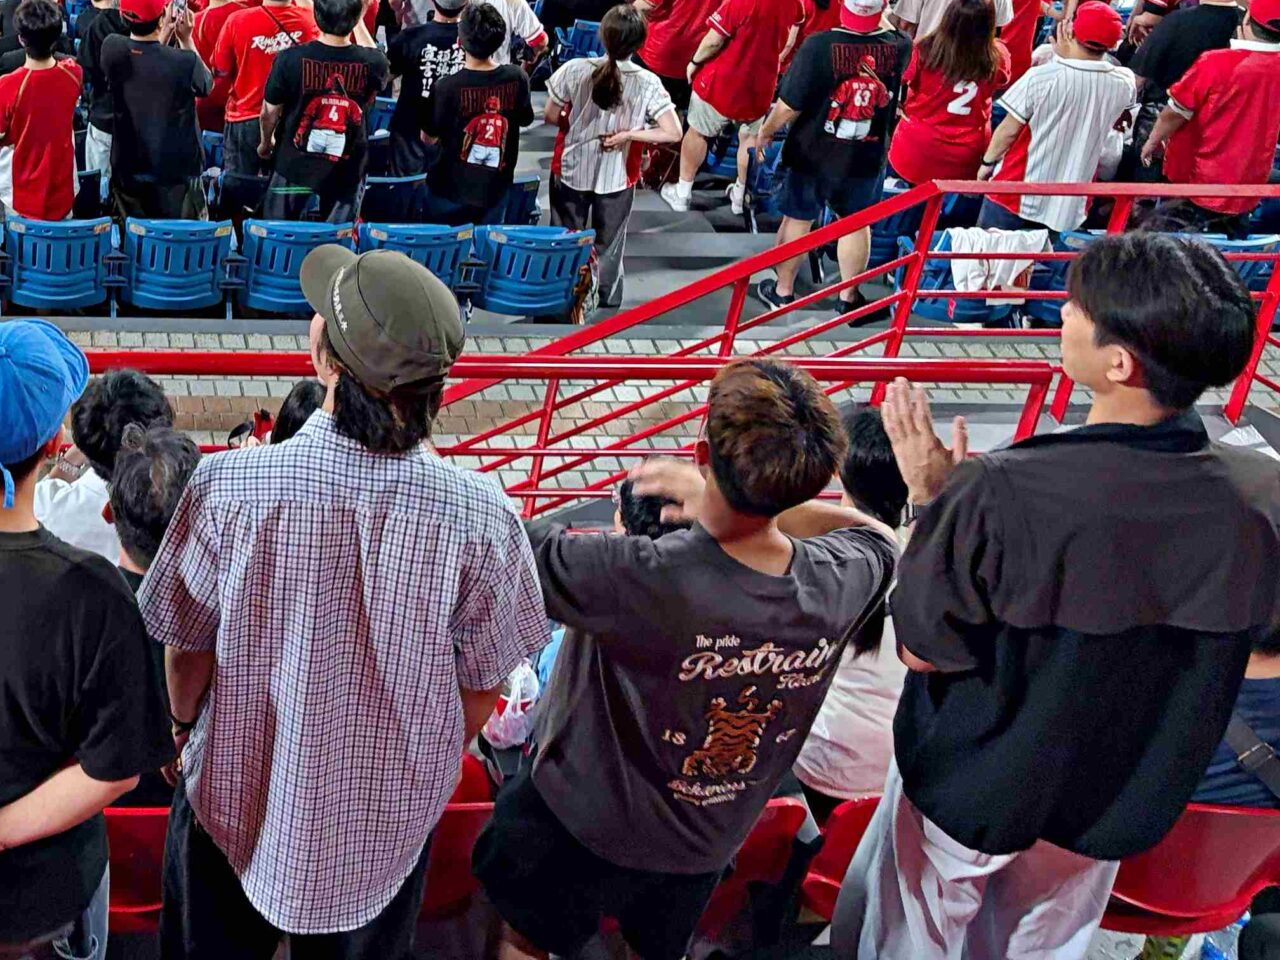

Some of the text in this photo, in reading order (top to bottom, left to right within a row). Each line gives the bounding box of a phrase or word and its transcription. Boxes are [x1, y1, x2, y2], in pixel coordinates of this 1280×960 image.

[853, 89, 872, 107] 63
[946, 82, 979, 116] 2
[328, 105, 339, 122] 4
[484, 124, 497, 140] 2
[695, 634, 741, 651] The pride
